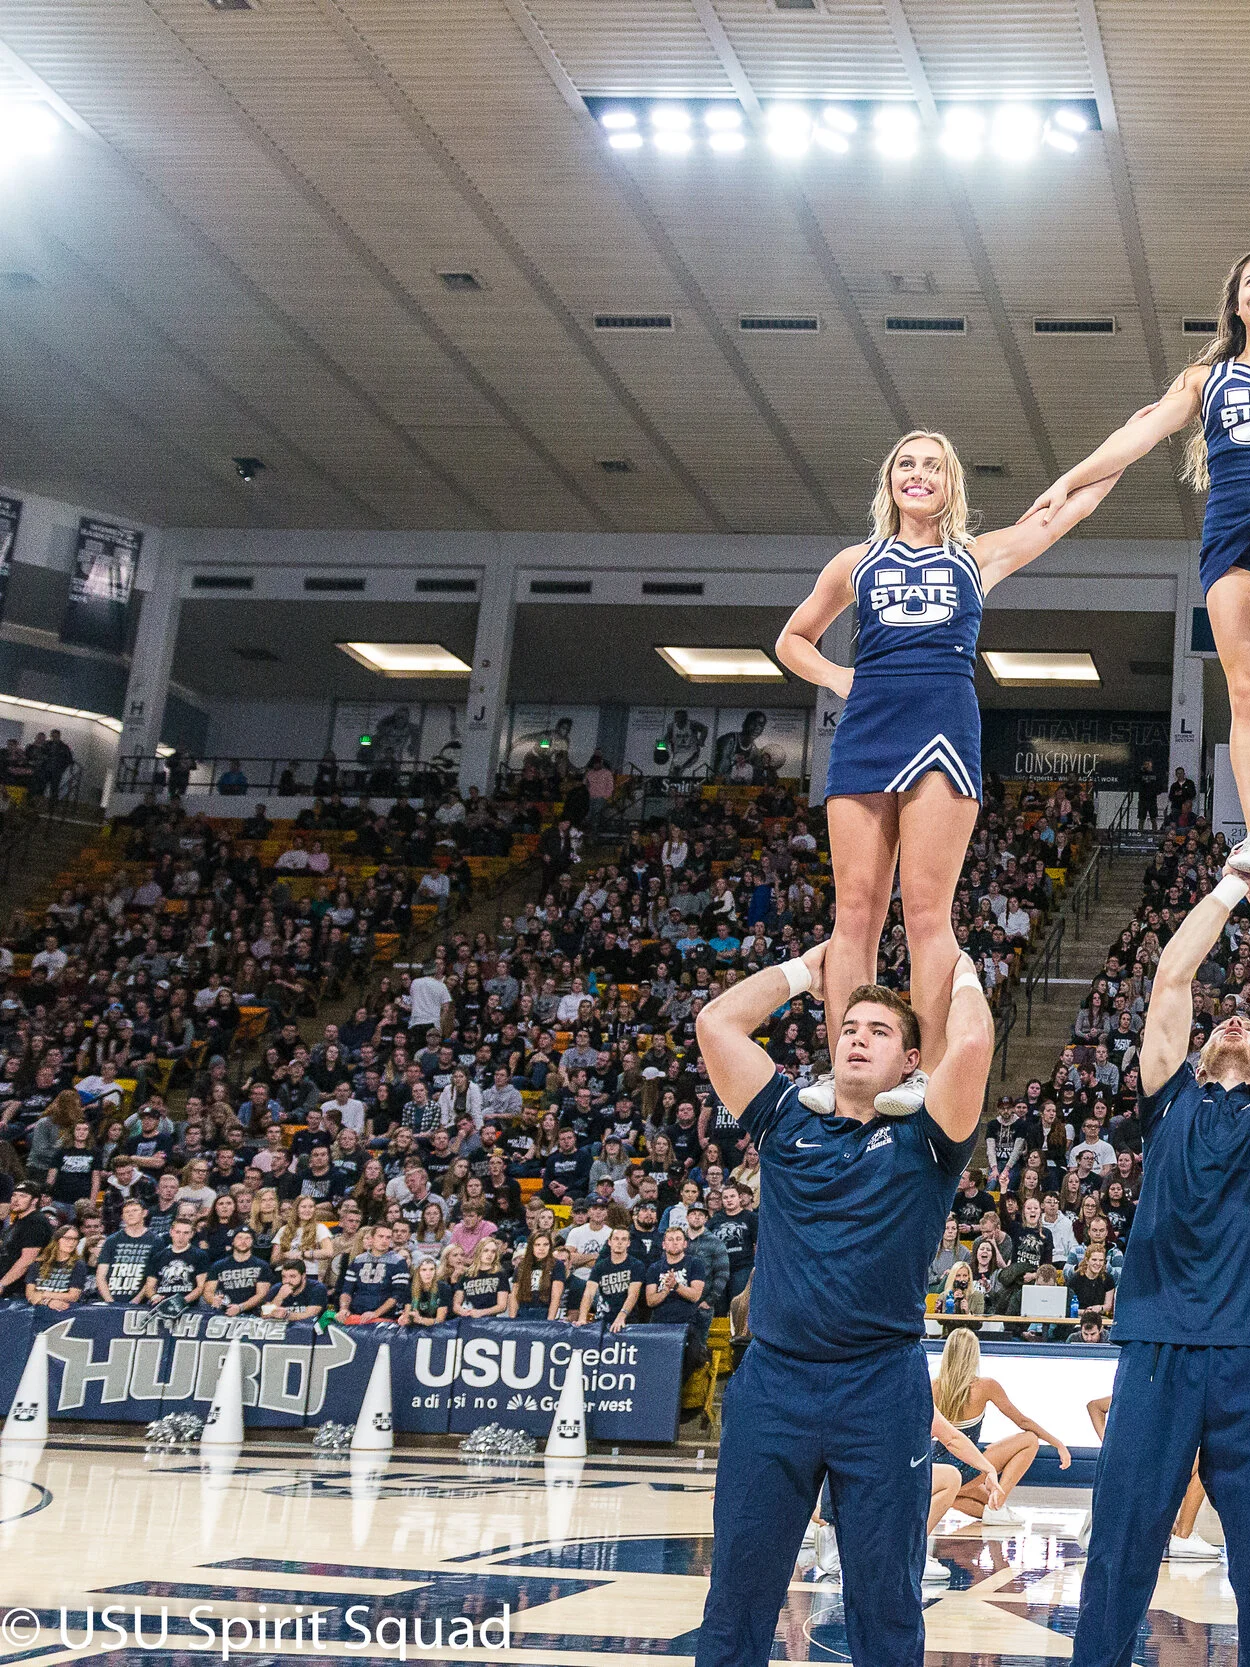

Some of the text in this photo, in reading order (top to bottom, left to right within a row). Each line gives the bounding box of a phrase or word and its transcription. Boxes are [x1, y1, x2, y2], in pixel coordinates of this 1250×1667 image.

[870, 585, 958, 611] STATE
[473, 706, 486, 721] J
[822, 711, 837, 727] K
[1180, 718, 1192, 734] L
[112, 1263, 146, 1277] TRUE
[108, 1277, 141, 1291] BLUE
[205, 1314, 288, 1341] STATE
[46, 1317, 357, 1416] HURD
[415, 1337, 545, 1390] USU
